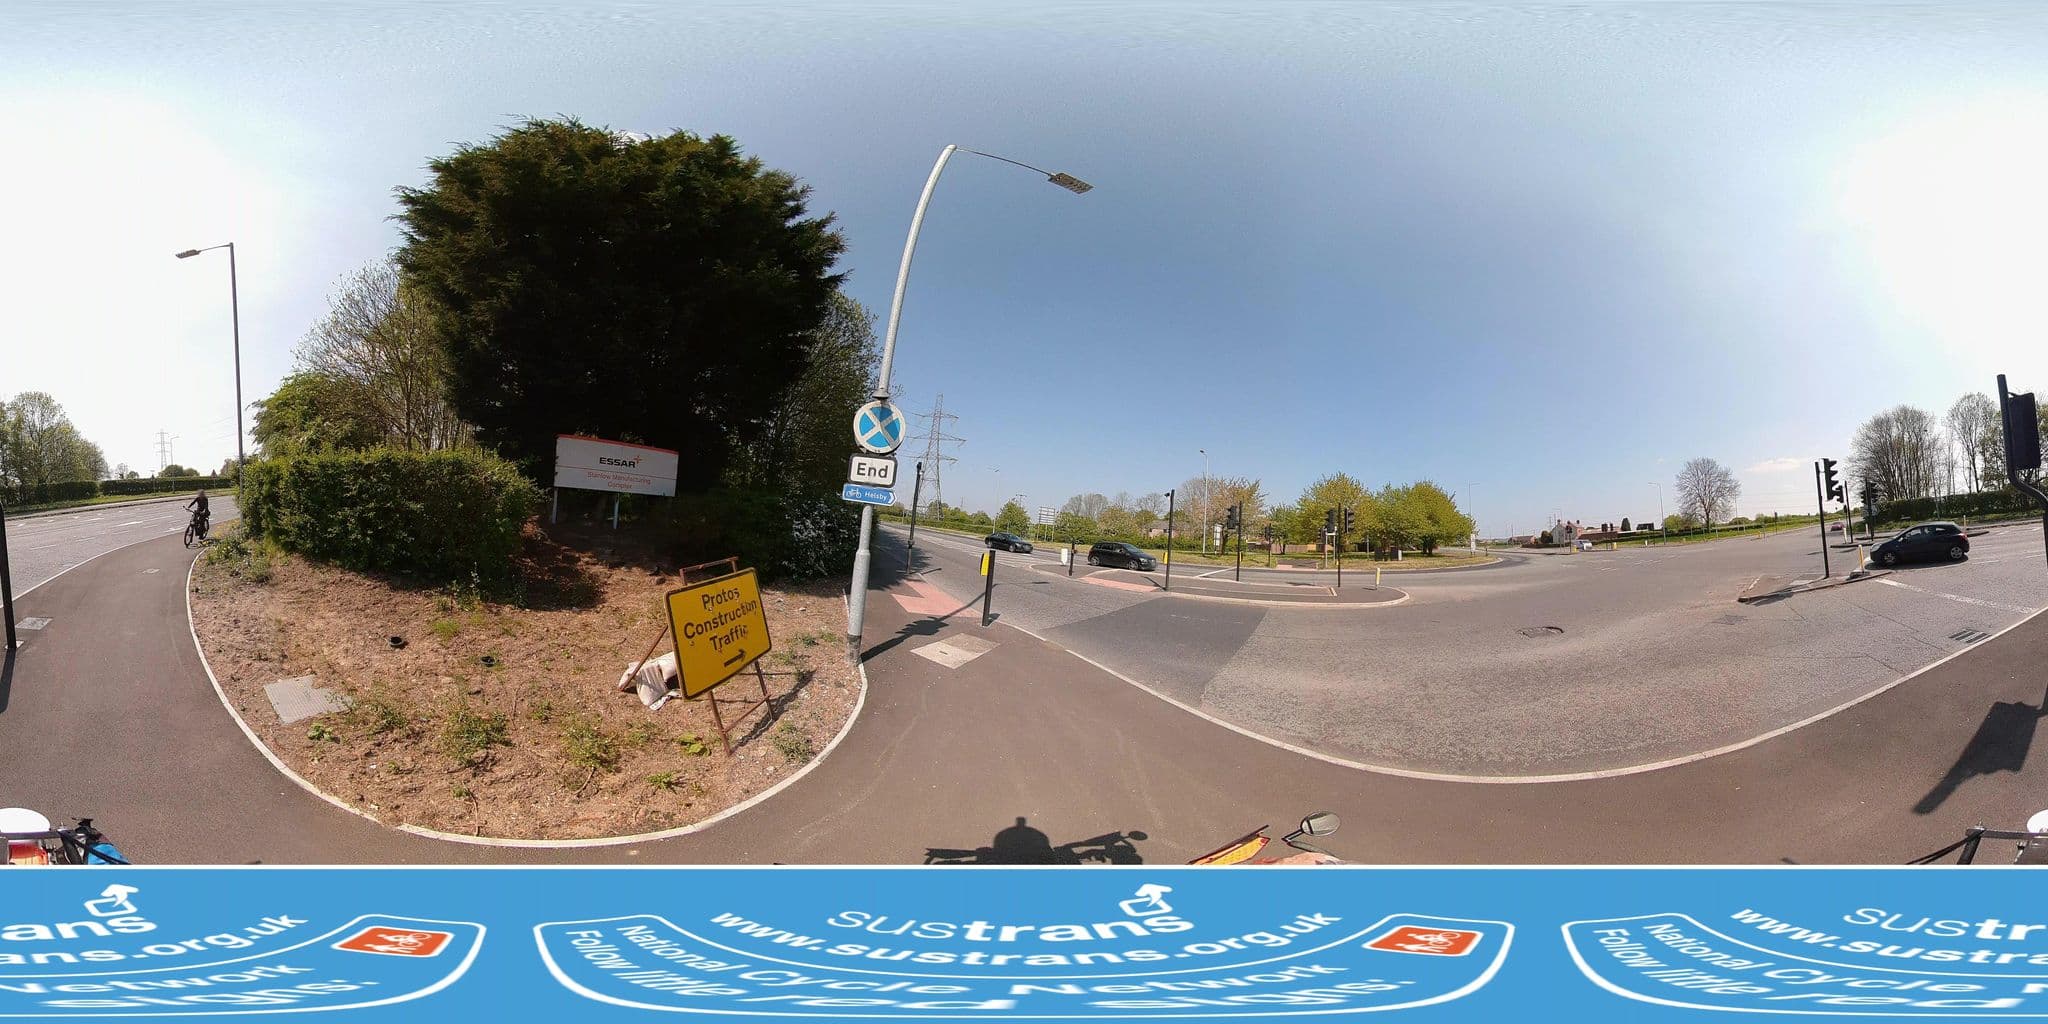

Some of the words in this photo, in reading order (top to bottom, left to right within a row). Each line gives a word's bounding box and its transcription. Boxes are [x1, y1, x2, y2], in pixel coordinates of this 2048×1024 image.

[599, 457, 636, 468] ESSAR
[857, 463, 889, 479] End
[702, 587, 740, 610] Protos
[684, 599, 757, 639] Construction
[709, 624, 748, 651] Traffic
